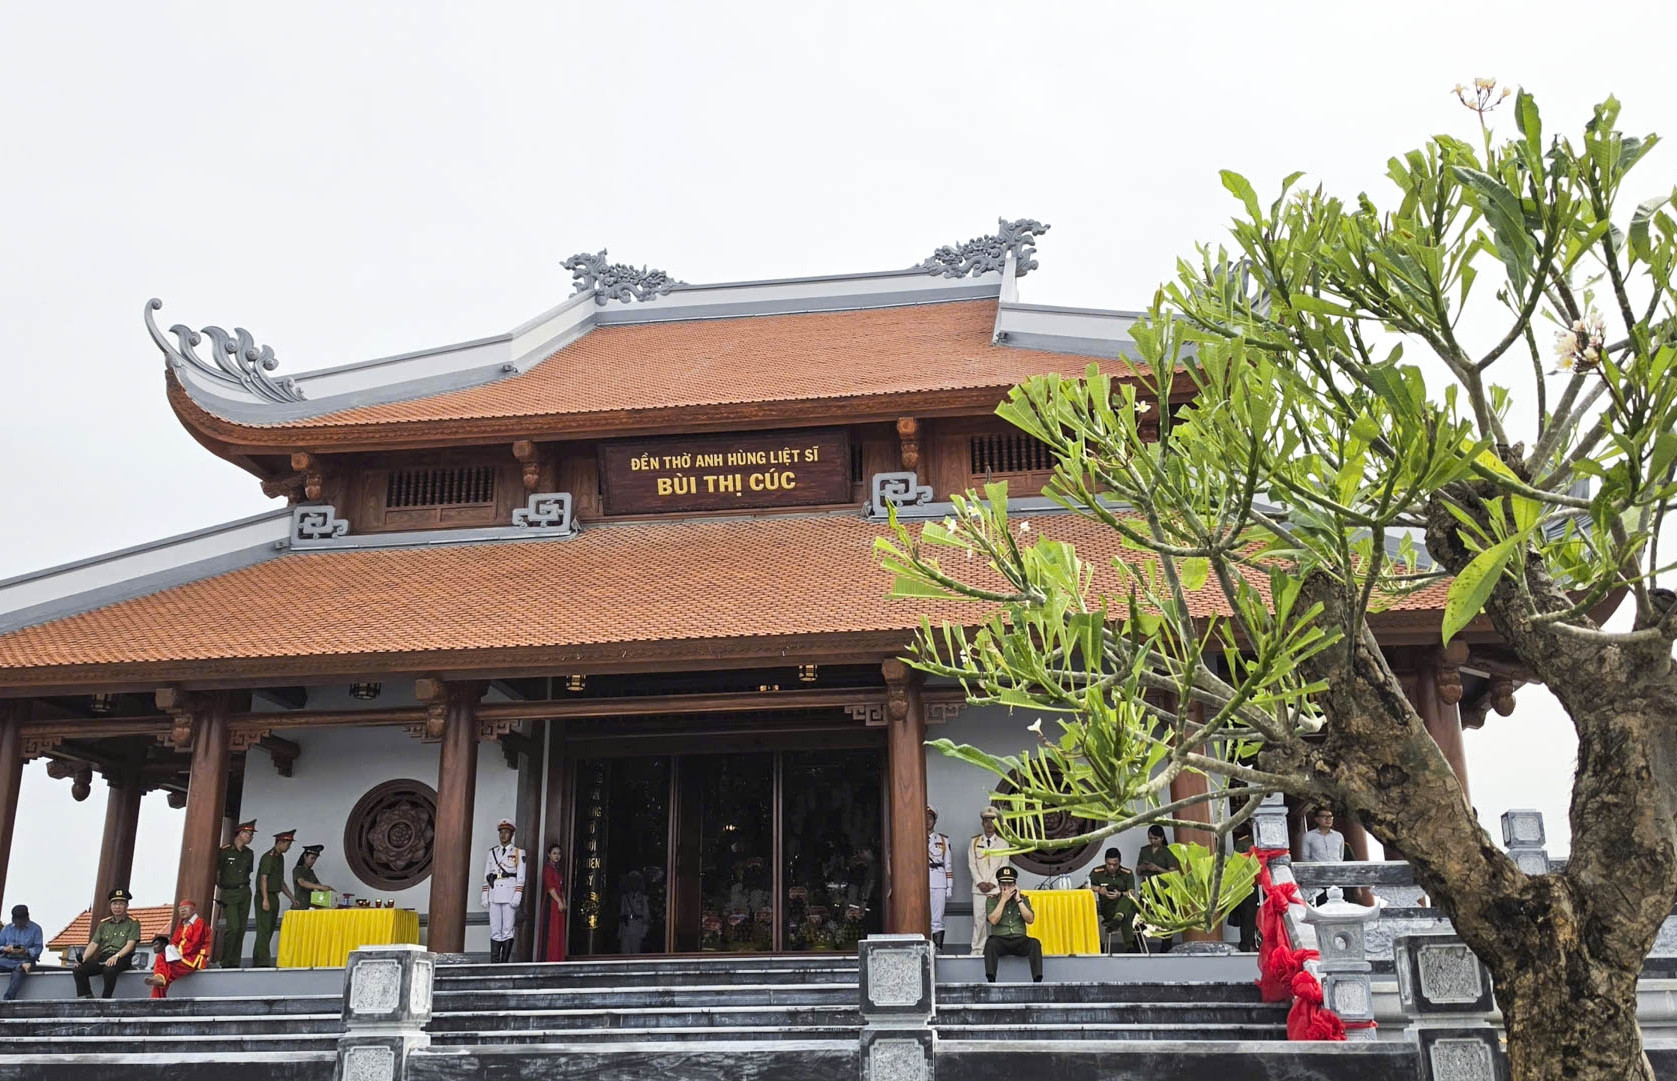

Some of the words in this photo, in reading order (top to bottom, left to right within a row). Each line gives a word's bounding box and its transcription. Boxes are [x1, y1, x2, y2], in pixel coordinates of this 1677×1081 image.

[630, 452, 660, 471] ĐỀN
[662, 452, 692, 469] THỜ
[696, 453, 724, 468] ANH
[728, 449, 767, 466] HÙNG
[769, 446, 801, 466] LIỆT
[804, 445, 819, 462] SĨ
[657, 472, 697, 496] BÙI
[702, 473, 742, 497] THỊ
[749, 467, 796, 491] CÚC
